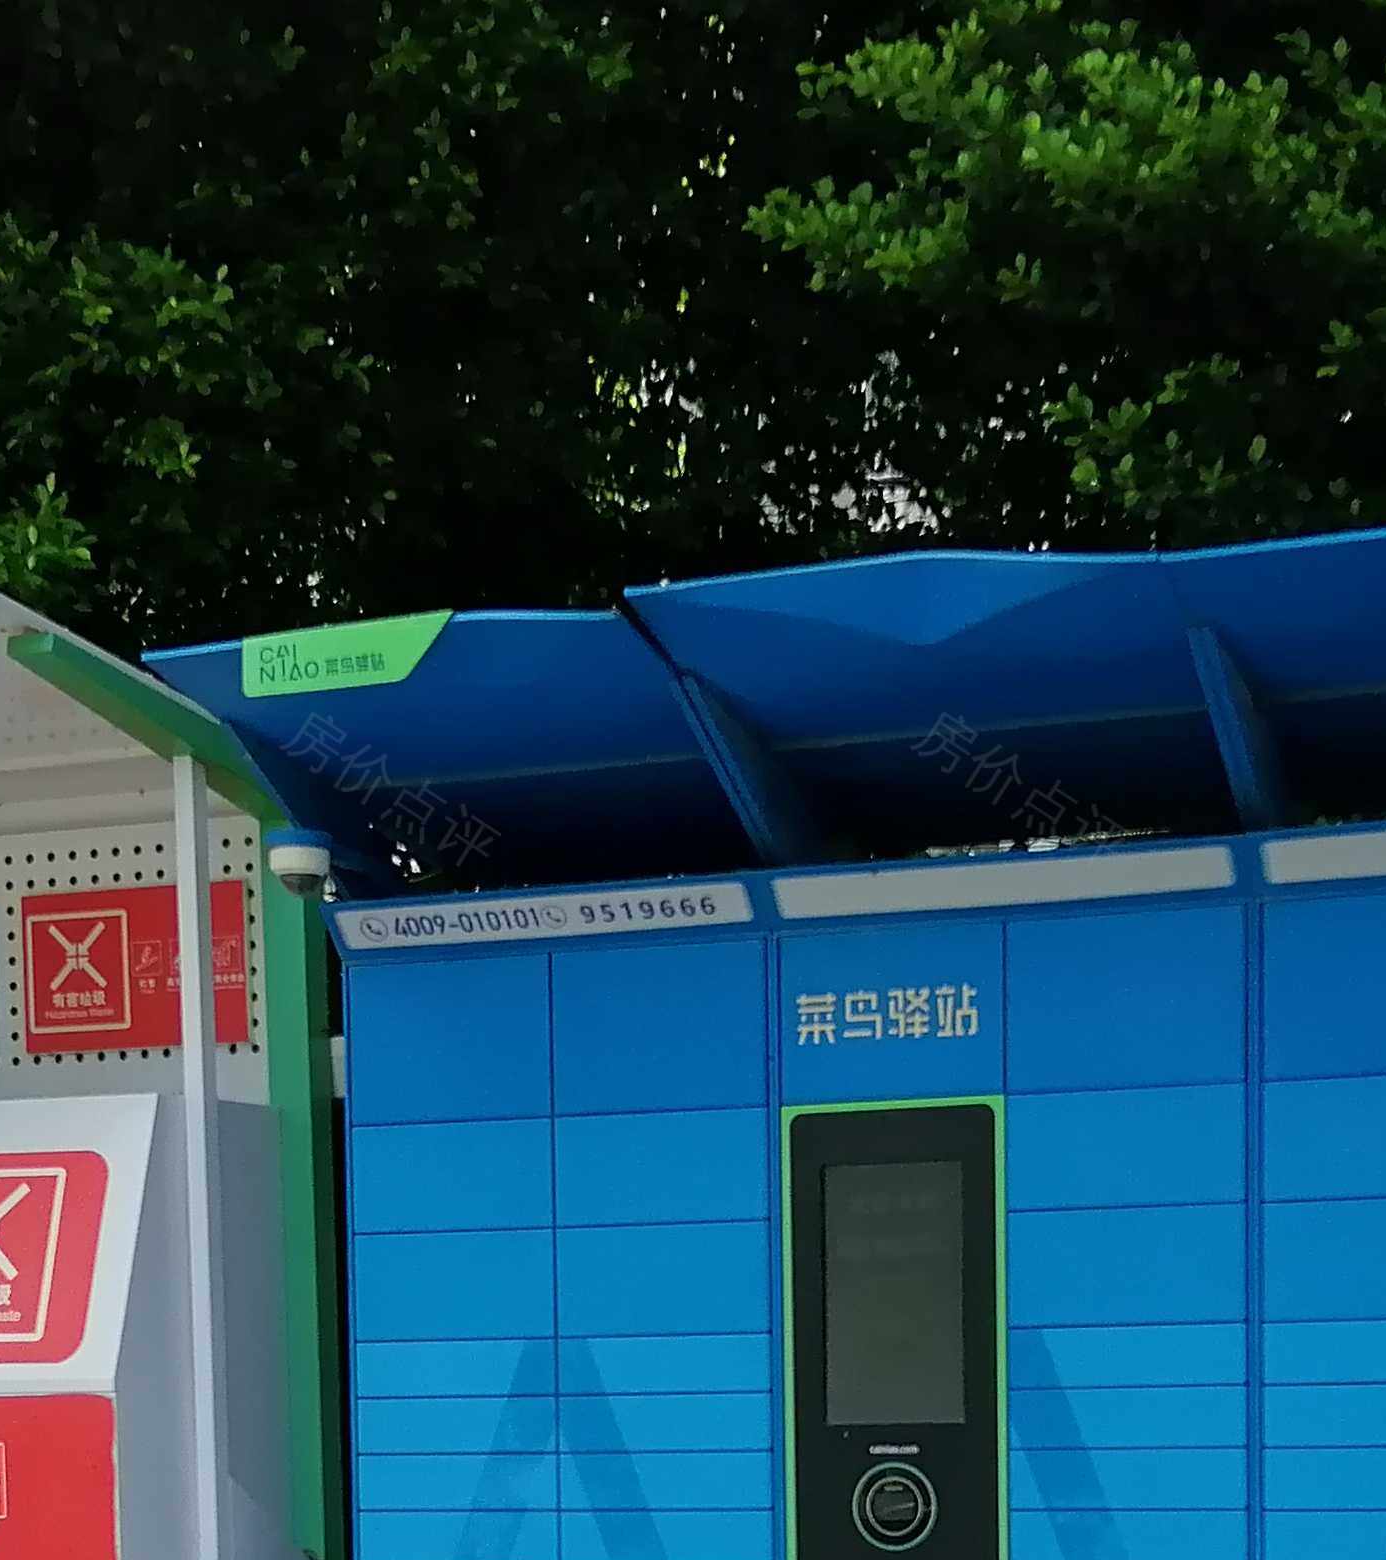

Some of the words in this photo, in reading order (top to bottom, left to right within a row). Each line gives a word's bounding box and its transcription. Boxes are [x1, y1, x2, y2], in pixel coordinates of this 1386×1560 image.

[325, 652, 385, 677] 菜鸟驿站
[392, 905, 540, 938] 4009-010101
[579, 896, 716, 925] 9519666
[52, 990, 106, 1009] 有害垃圾
[796, 983, 979, 1046] 菜鸟驿站
